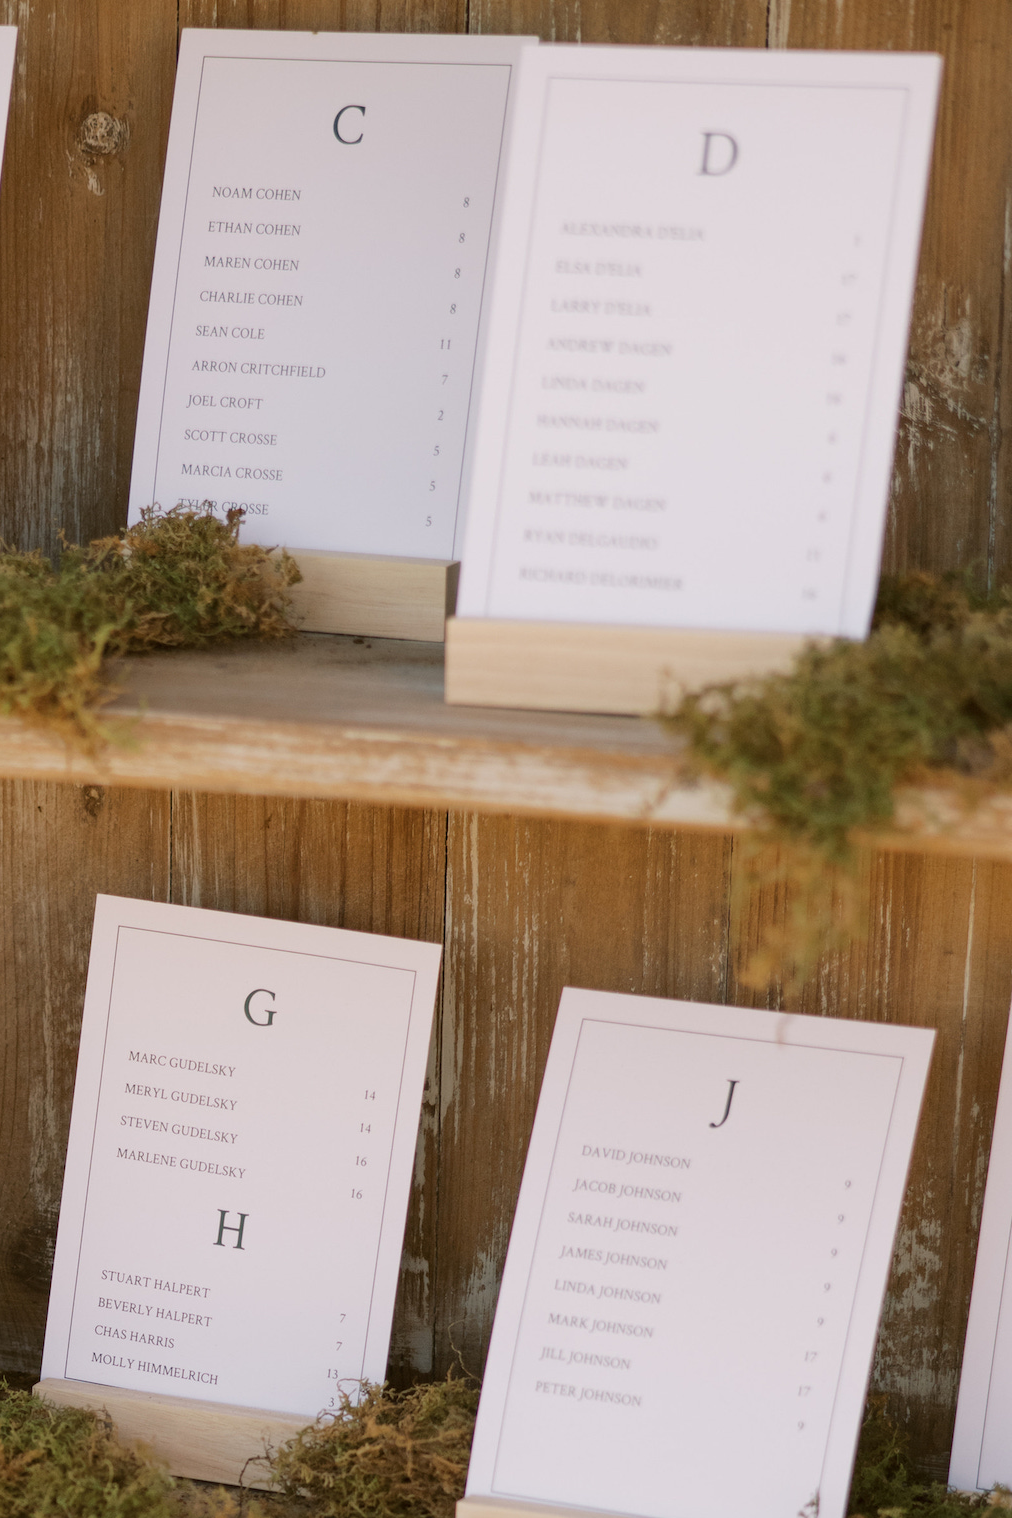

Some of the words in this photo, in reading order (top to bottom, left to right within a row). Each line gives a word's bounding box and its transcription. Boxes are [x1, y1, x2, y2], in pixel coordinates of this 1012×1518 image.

[333, 105, 366, 145] C
[697, 131, 740, 177] D
[212, 186, 253, 199] NOAM
[256, 188, 301, 201] COHEN
[463, 197, 470, 208] 8
[208, 221, 253, 234] ETHAN
[256, 223, 301, 236] COHEN
[458, 232, 466, 243] 8
[204, 256, 251, 268] MAREN
[254, 258, 299, 271] COHEN
[454, 268, 461, 279] 8
[199, 291, 255, 304] CHARLIE
[258, 293, 303, 306] COHEN
[450, 303, 457, 314] 8
[195, 325, 228, 337] SEAN
[231, 327, 265, 339] COLE
[440, 339, 451, 350] 11
[192, 360, 237, 373] ARRON
[240, 363, 326, 378] CRITCHFIELD
[442, 374, 449, 385] 7
[186, 394, 216, 408] JOEL
[220, 396, 263, 409] CROFT
[437, 410, 444, 421] 2
[184, 429, 227, 442] SCOTT
[229, 432, 277, 445] CROSSE
[433, 445, 440, 456] 5
[181, 463, 232, 478] MARCIA
[235, 467, 283, 481] CROSSE
[429, 480, 436, 491] 5
[425, 516, 432, 527] 5
[244, 988, 277, 1027] G
[128, 1051, 167, 1066] MARC
[169, 1057, 236, 1077] GUDELSKY
[364, 1090, 376, 1101] 14
[125, 1083, 167, 1100] MERYL
[171, 1091, 237, 1111] GUDELSKY
[360, 1123, 371, 1134] 14
[709, 1080, 739, 1128] J
[120, 1115, 169, 1132] STEVEN
[171, 1124, 238, 1144] GUDELSKY
[356, 1156, 367, 1167] 16
[116, 1147, 177, 1167] MARLENE
[179, 1158, 246, 1179] GUDELSKY
[351, 1188, 363, 1200] 16
[582, 1145, 626, 1161] DAVID
[627, 1151, 691, 1169] JOHNSON
[844, 1180, 852, 1189] 9
[572, 1178, 616, 1194] JACOB
[617, 1185, 681, 1202] JOHNSON
[837, 1213, 845, 1223] 9
[213, 1209, 249, 1250] H
[567, 1212, 613, 1228] SARAH
[613, 1219, 678, 1236] JOHNSON
[830, 1248, 838, 1257] 9
[559, 1245, 604, 1265] JAMES
[604, 1252, 667, 1270] JOHNSON
[823, 1282, 832, 1292] 9
[101, 1269, 152, 1287] STUART
[154, 1279, 211, 1298] HALPERT
[340, 1313, 346, 1323] 7
[554, 1279, 595, 1295] LINDA
[597, 1286, 661, 1304] JOHNSON
[816, 1317, 825, 1327] 9
[98, 1297, 153, 1316] BEVERLY
[156, 1307, 213, 1327] HALPERT
[336, 1341, 343, 1351] 7
[548, 1313, 587, 1329] MARK
[590, 1319, 653, 1338] JOHNSON
[804, 1351, 818, 1362] 17
[94, 1325, 127, 1340] CHAS
[130, 1331, 175, 1349] HARRIS
[327, 1369, 338, 1380] 13
[539, 1347, 565, 1361] JILL
[567, 1351, 631, 1370] JOHNSON
[797, 1385, 812, 1397] 17
[91, 1352, 135, 1369] MOLLY
[137, 1360, 218, 1385] HIMMELRICH
[328, 1397, 335, 1408] 3
[535, 1380, 576, 1397] PETER
[578, 1387, 642, 1406] JOHNSON
[797, 1421, 805, 1431] 9
